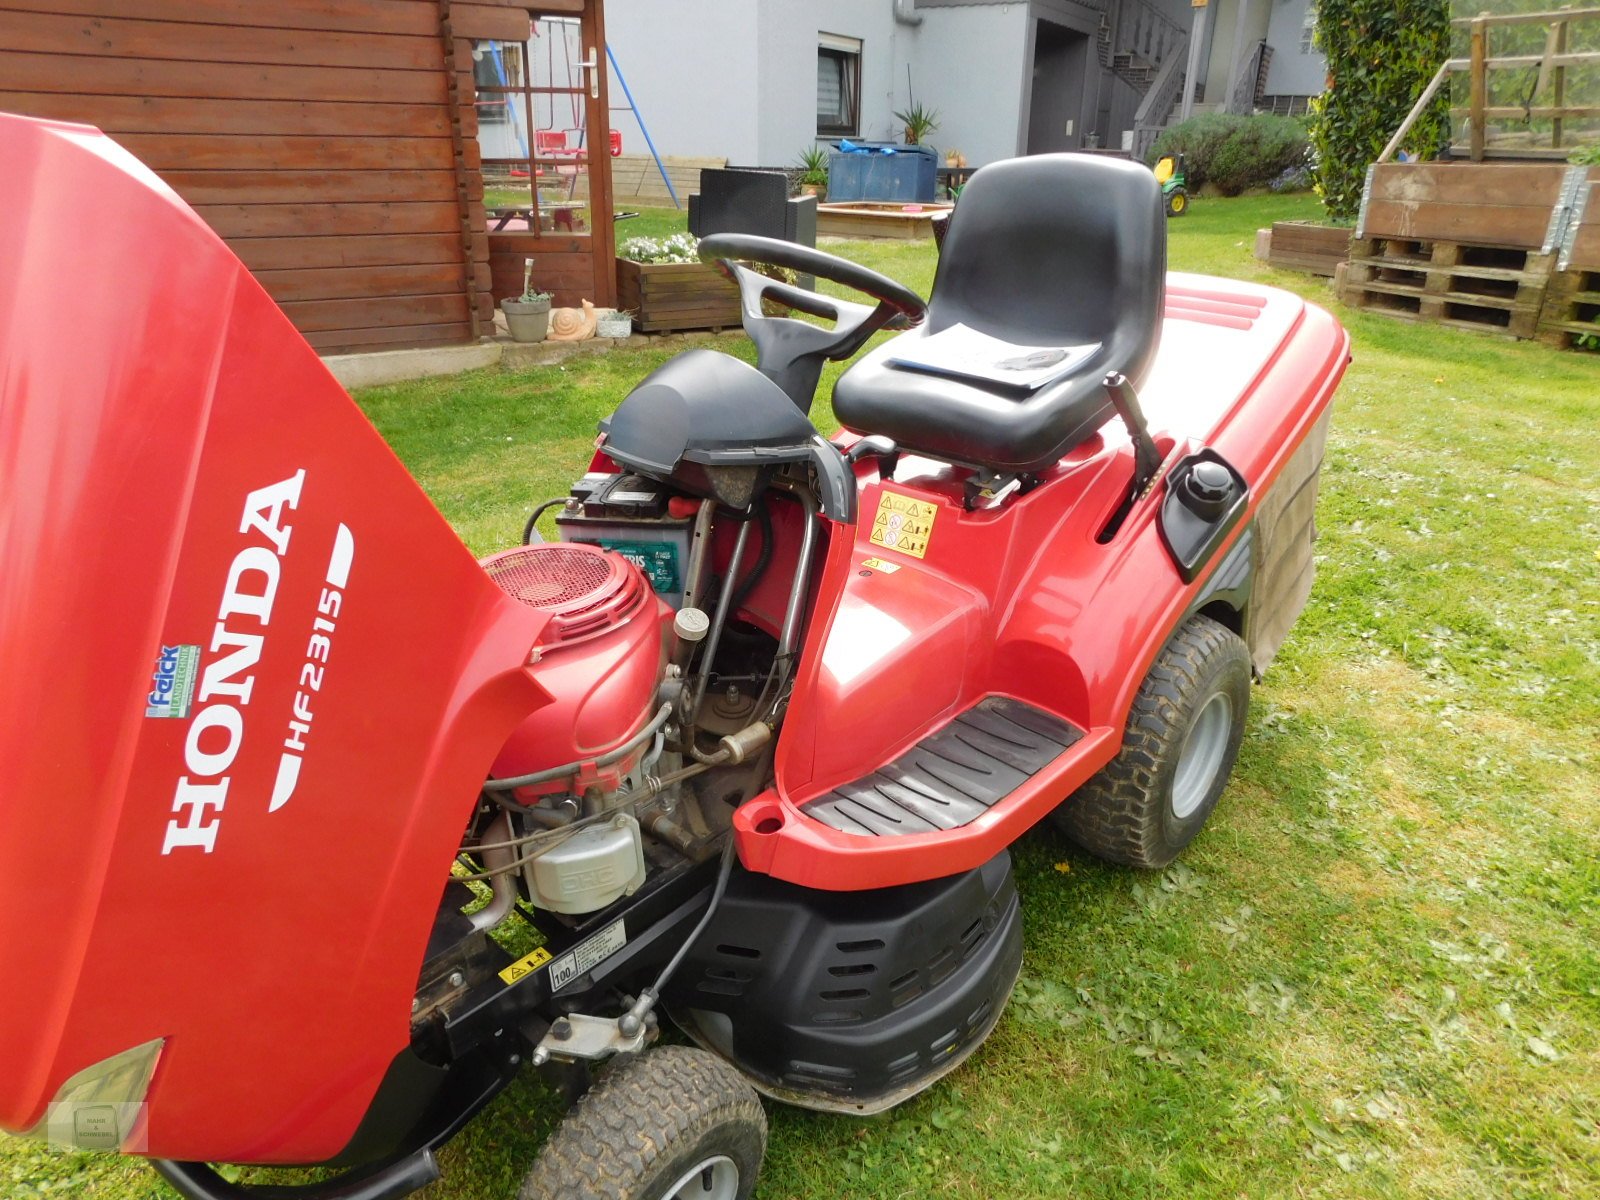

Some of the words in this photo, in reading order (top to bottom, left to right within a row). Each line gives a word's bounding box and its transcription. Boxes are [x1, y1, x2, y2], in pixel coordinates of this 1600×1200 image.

[161, 468, 306, 855] HONDA
[173, 646, 190, 706] LANDTECHNIK
[284, 588, 342, 751] HF2315
[554, 967, 571, 985] 100
